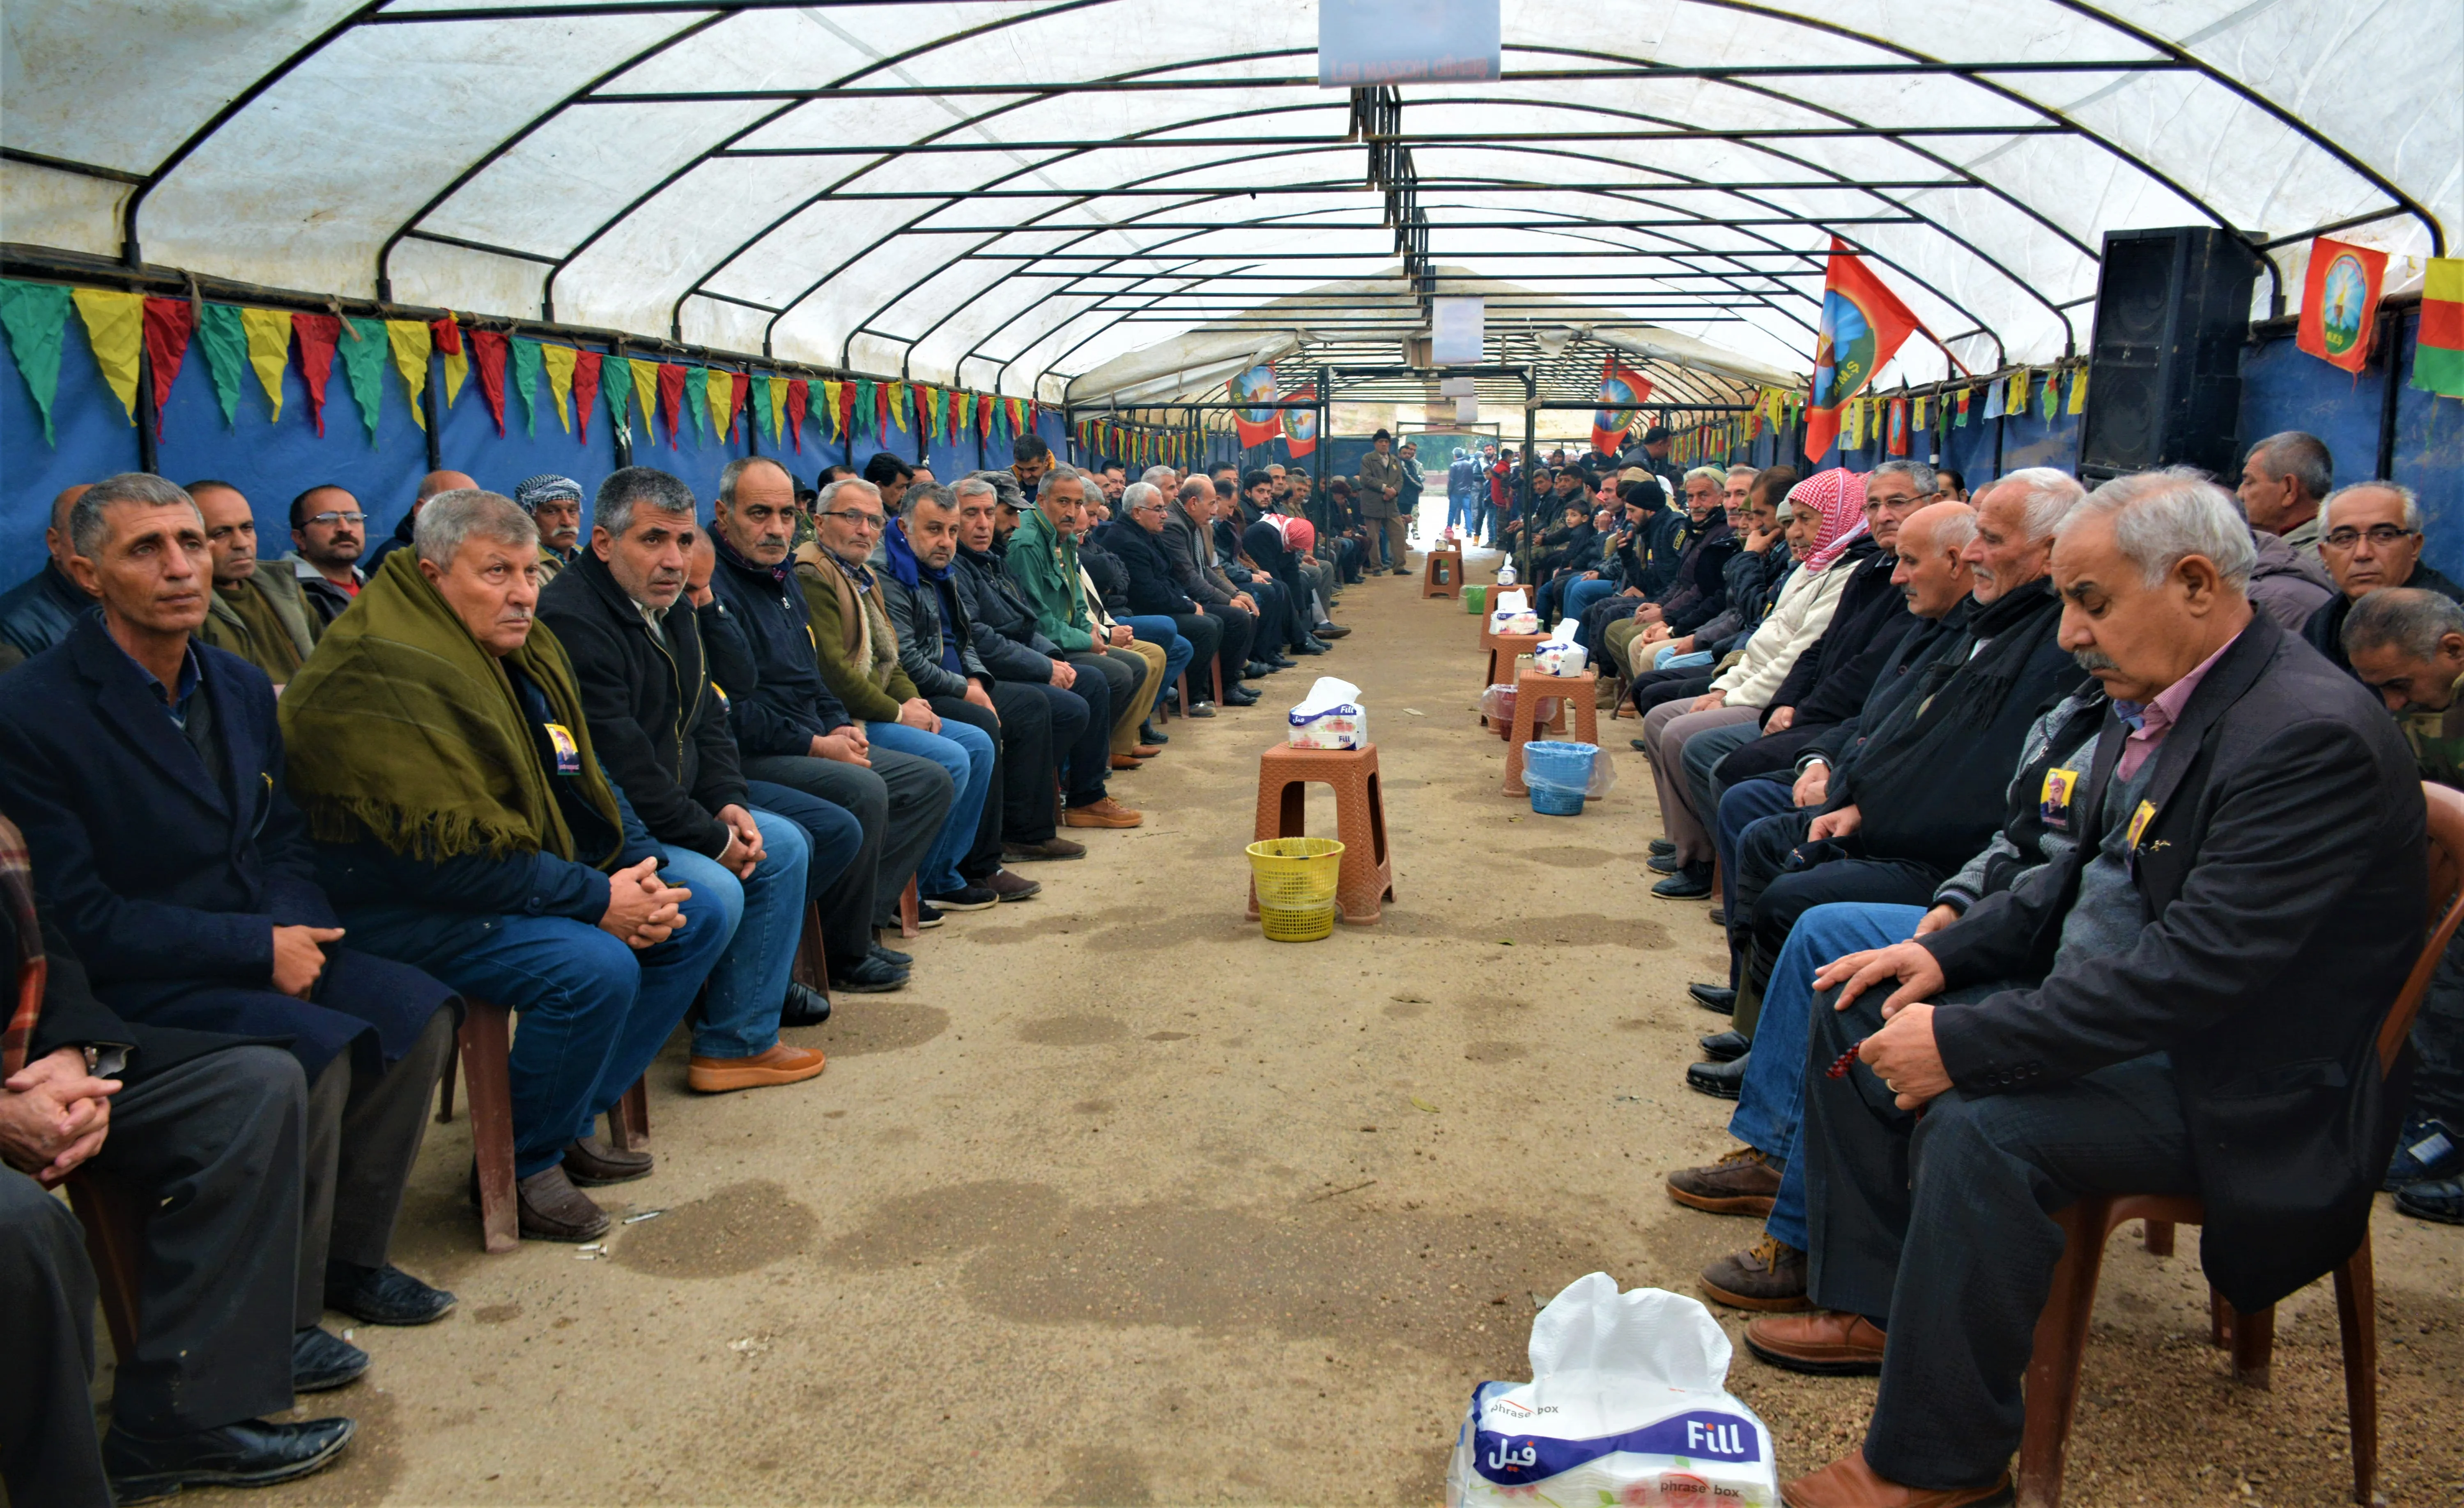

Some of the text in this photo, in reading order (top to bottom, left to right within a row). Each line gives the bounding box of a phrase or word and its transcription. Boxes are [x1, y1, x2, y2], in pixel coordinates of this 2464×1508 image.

[1687, 1420, 1744, 1454] Fill
[1489, 1438, 1536, 1472] فيل
[1660, 1480, 1740, 1497] phrase box
